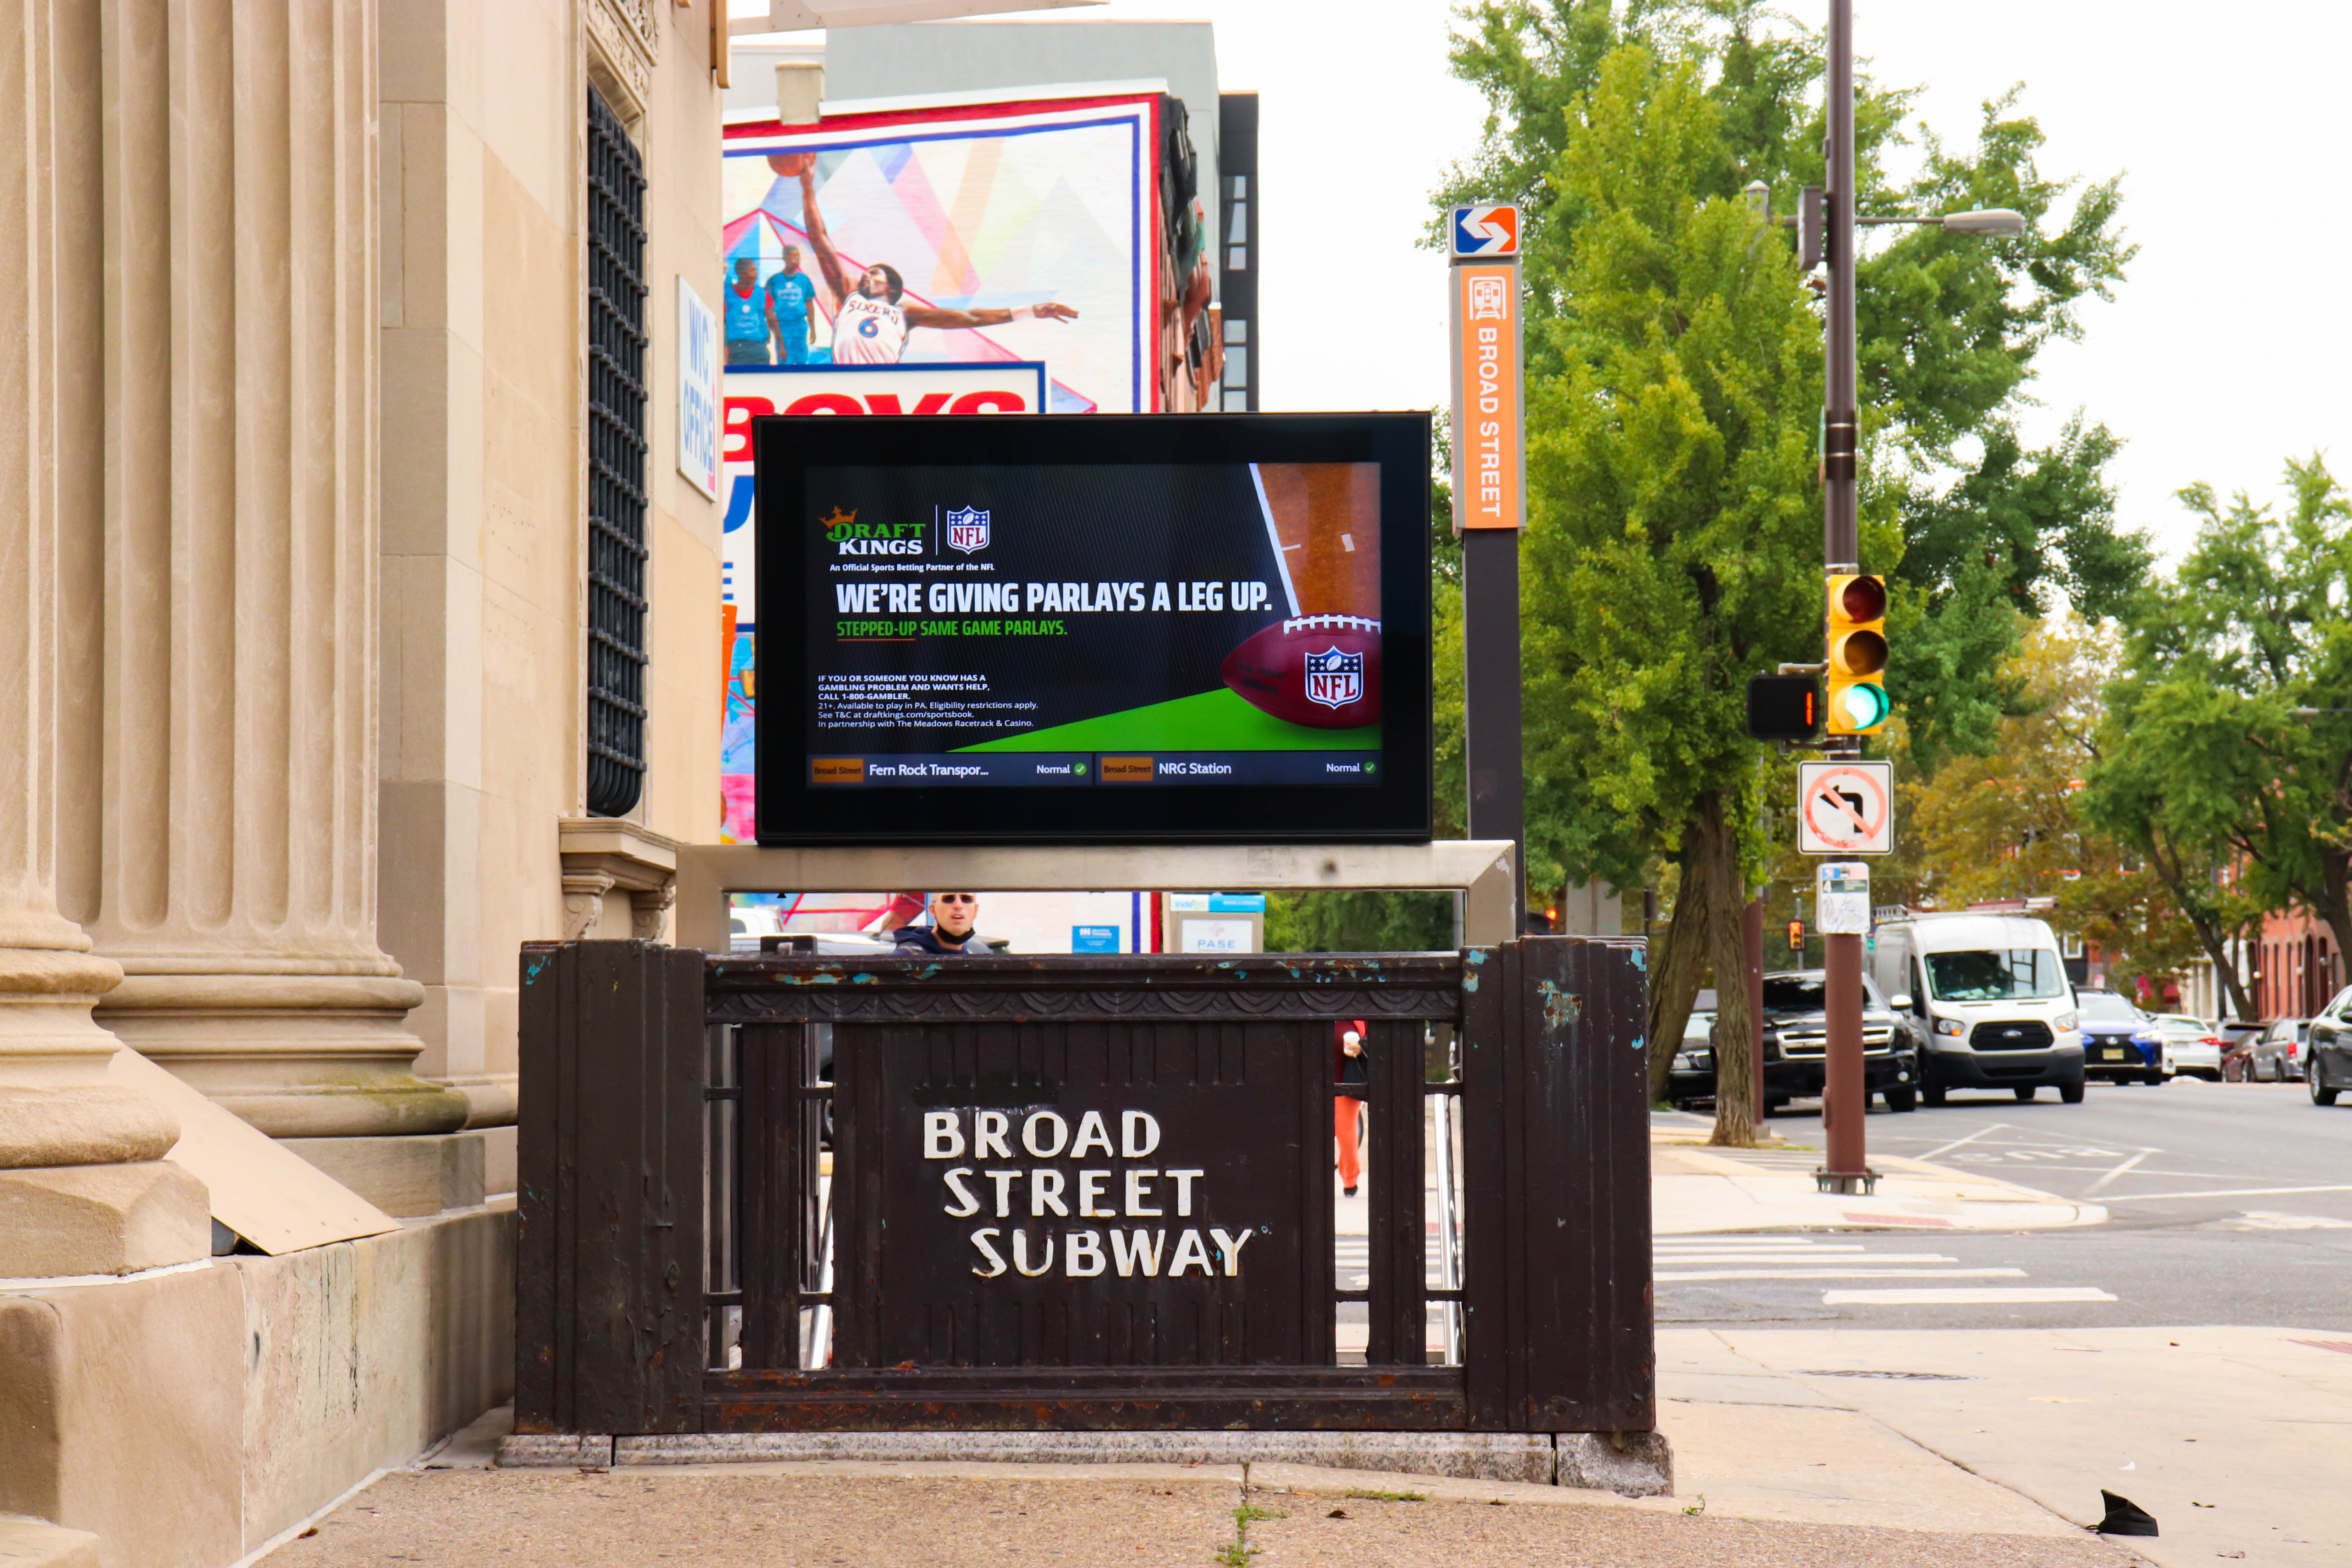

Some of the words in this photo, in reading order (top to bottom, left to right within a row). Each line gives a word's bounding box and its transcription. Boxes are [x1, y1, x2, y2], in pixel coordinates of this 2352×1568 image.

[858, 316, 880, 338] 6
[689, 298, 709, 385] WIC
[1479, 328, 1499, 414] BROAD
[683, 379, 713, 474] OFFICE
[1480, 421, 1500, 517] STREET
[826, 523, 926, 542] DRAFT
[953, 527, 984, 546] NFL
[838, 538, 924, 555] KINGS
[871, 564, 895, 573] Sports
[897, 563, 924, 573] Betting
[929, 583, 1019, 613] GIVING
[1027, 582, 1145, 612] PARLAYS
[1151, 582, 1171, 611] A
[1178, 582, 1223, 611] LEG
[1231, 582, 1272, 611] UP.
[837, 621, 917, 636] STEPPED-UP
[920, 621, 958, 635] SAME
[962, 621, 1001, 635] GAME
[1005, 620, 1068, 635] PARLAYS.
[1313, 673, 1356, 701] NFL
[863, 711, 974, 719] draftkings.com/sportsbook.
[886, 702, 903, 711] play
[930, 702, 965, 711] Eligibility
[1014, 702, 1038, 710] apply.
[828, 720, 875, 729] partnership
[814, 767, 837, 775] Broad
[838, 767, 862, 775] Street
[869, 764, 896, 776] Fern
[898, 763, 927, 776] Rock
[1036, 764, 1071, 774] Normal
[1103, 765, 1126, 773] Broad
[1128, 765, 1151, 773] Street
[1159, 763, 1187, 774] NRG
[1189, 762, 1232, 774] Station
[1327, 762, 1360, 772] Normal
[1198, 940, 1235, 949] PASE
[924, 1111, 1161, 1160] BROAD
[944, 1167, 1204, 1218] STREET
[970, 1227, 1253, 1278] SUBWAY
